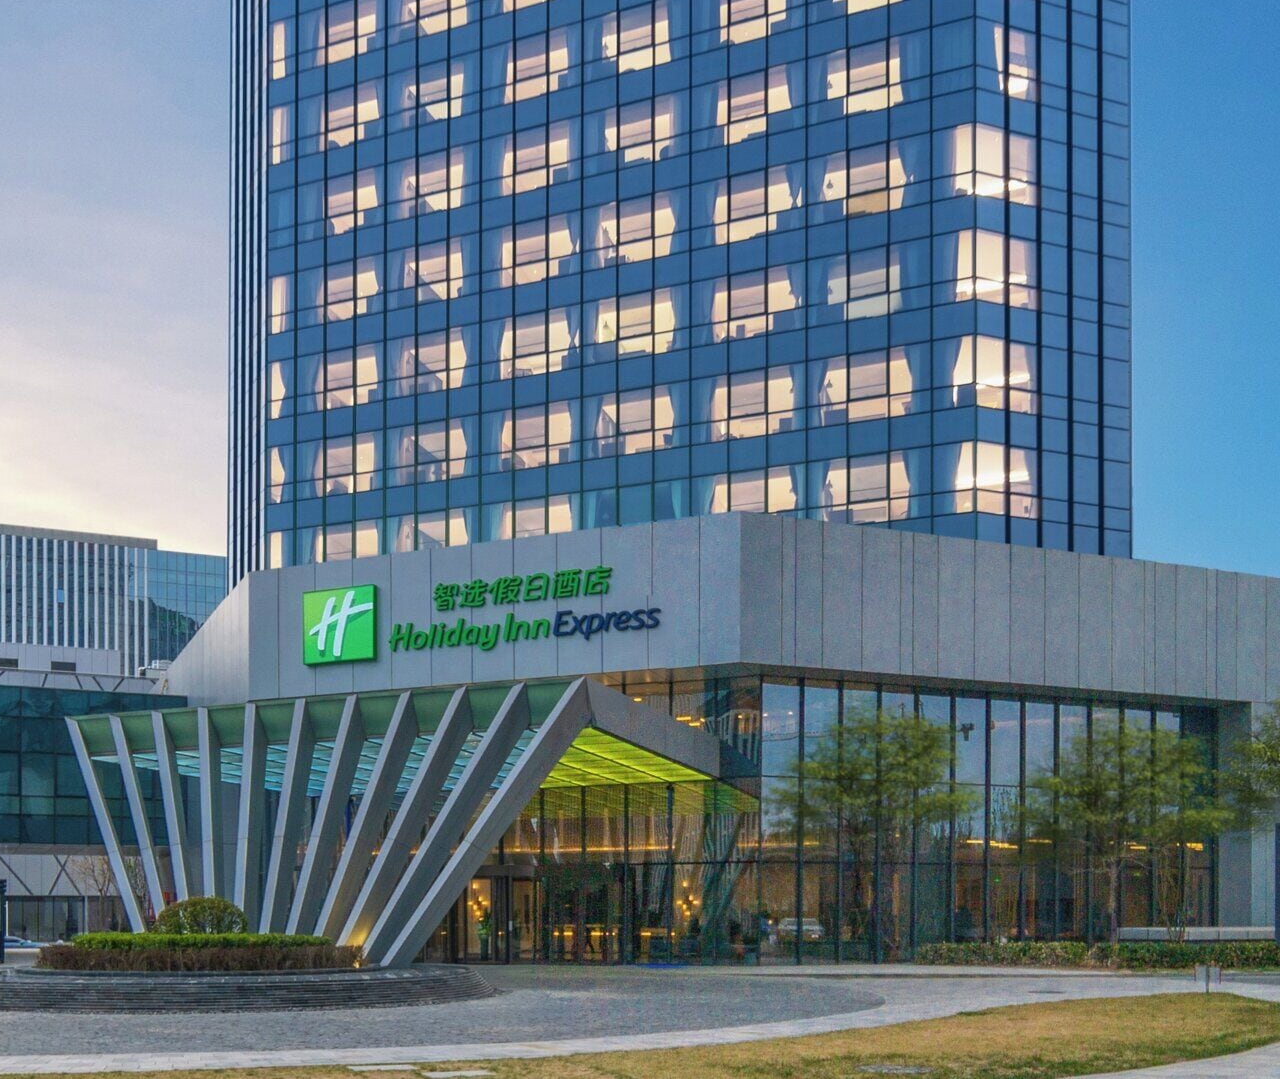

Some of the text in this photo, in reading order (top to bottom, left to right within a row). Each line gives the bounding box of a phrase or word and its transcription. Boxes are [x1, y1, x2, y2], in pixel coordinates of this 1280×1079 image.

[433, 566, 612, 611] 智选假日酒店
[389, 608, 662, 651] Holiday Inn Express
